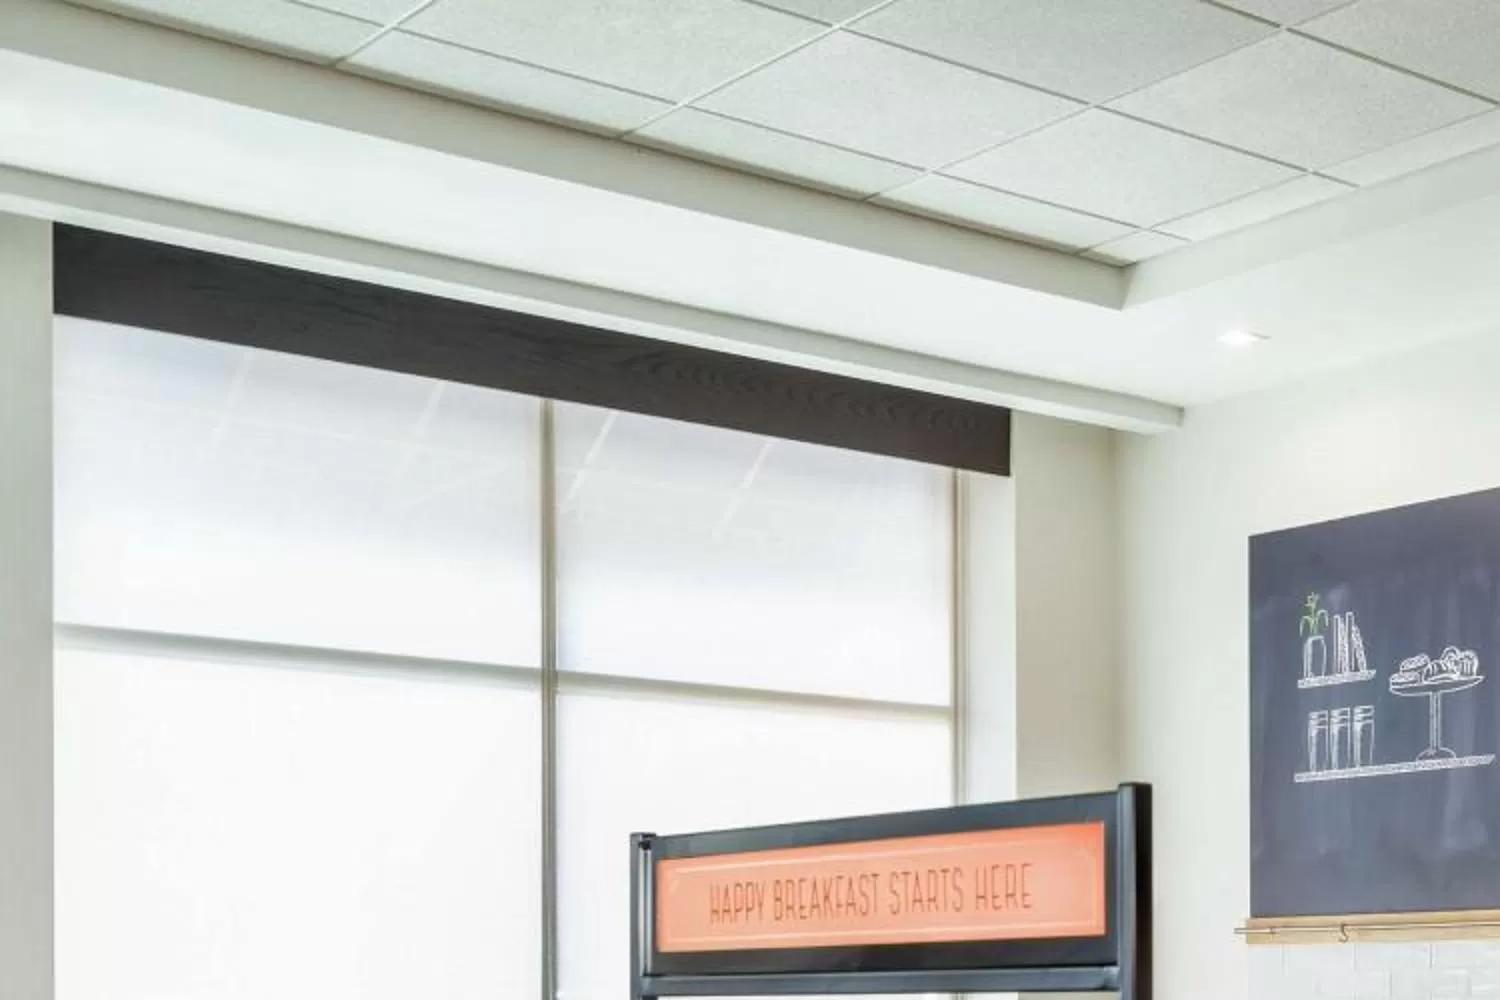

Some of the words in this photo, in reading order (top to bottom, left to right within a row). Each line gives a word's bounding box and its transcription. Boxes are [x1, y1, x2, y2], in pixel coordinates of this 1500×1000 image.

[710, 880, 765, 924] HAPPY
[773, 873, 880, 921] BREAKFAST
[889, 867, 965, 916] STARTS
[975, 862, 1034, 912] HERE
